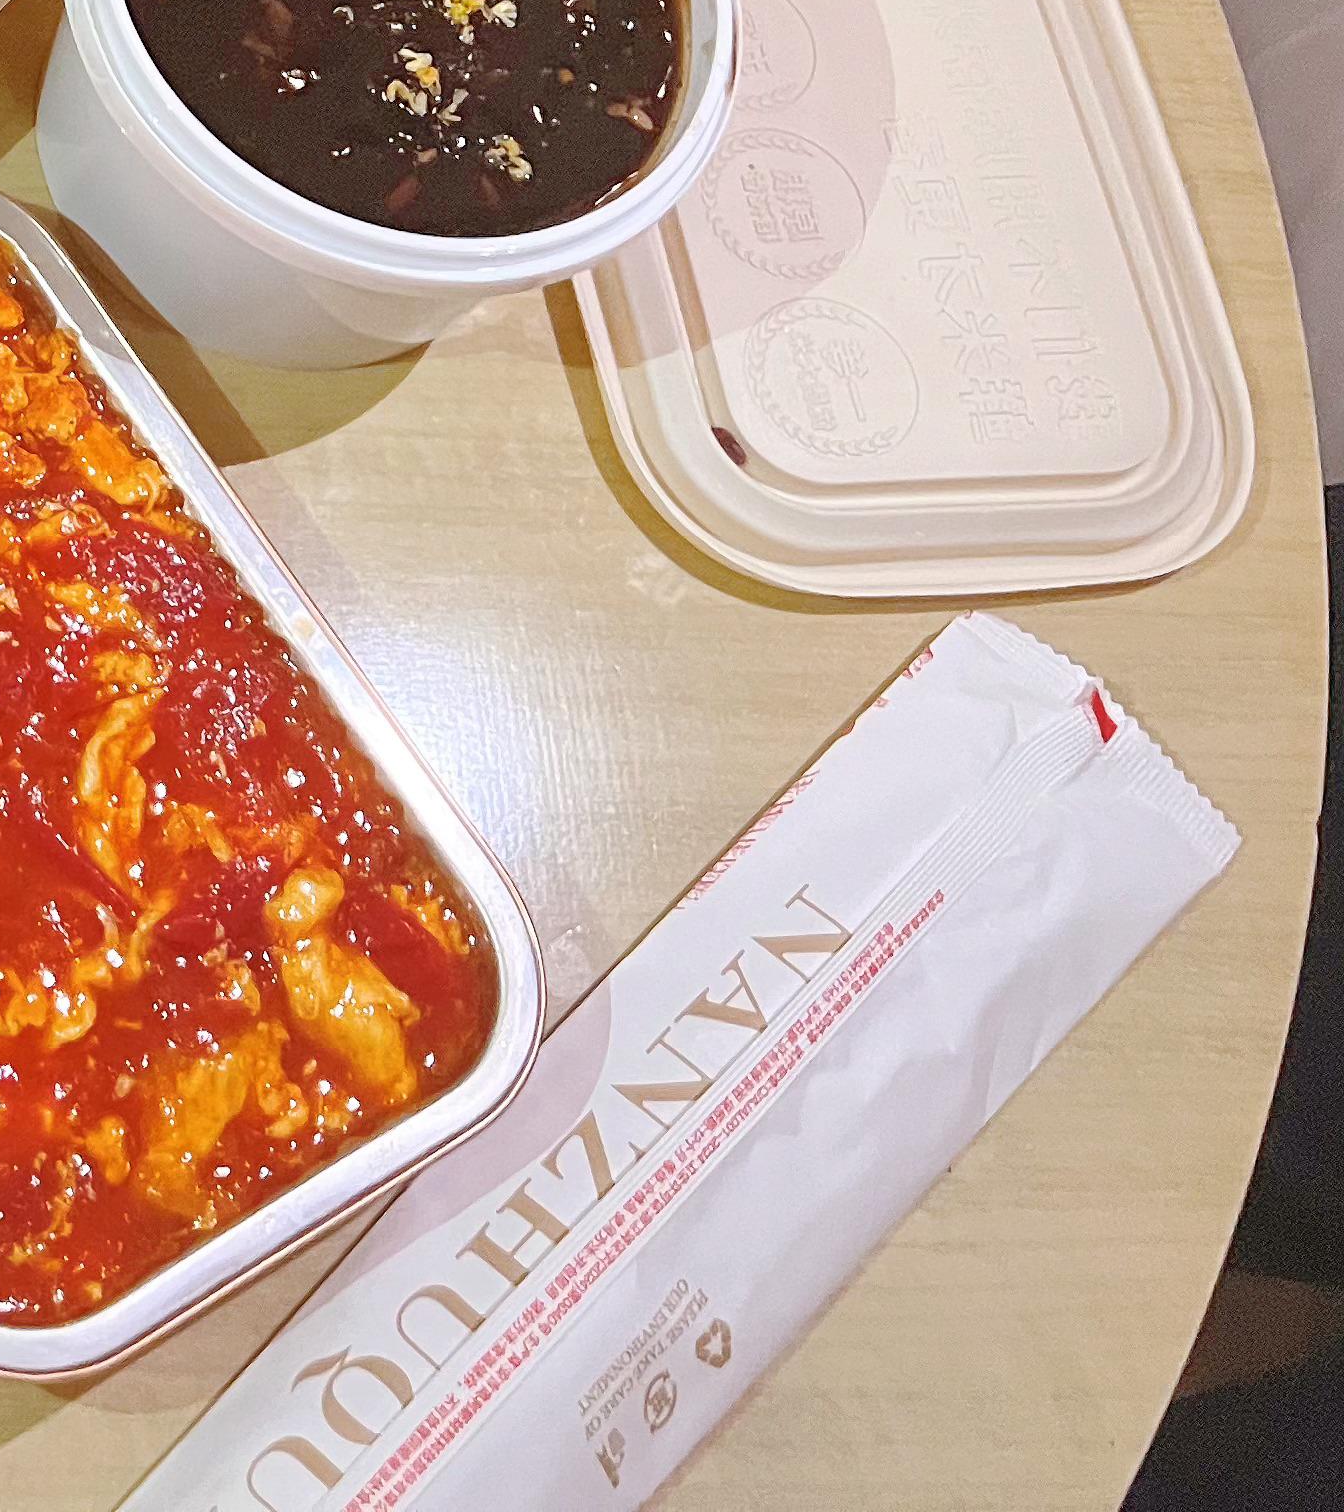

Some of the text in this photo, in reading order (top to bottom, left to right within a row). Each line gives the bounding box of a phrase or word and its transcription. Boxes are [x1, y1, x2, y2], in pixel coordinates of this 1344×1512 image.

[210, 884, 852, 1512] NANZHUQU
[665, 1288, 708, 1344] PLEASE
[577, 1279, 689, 1417] OUR ENVIRONMENT
[633, 1341, 667, 1379] TAKE
[603, 1378, 634, 1418] CARE
